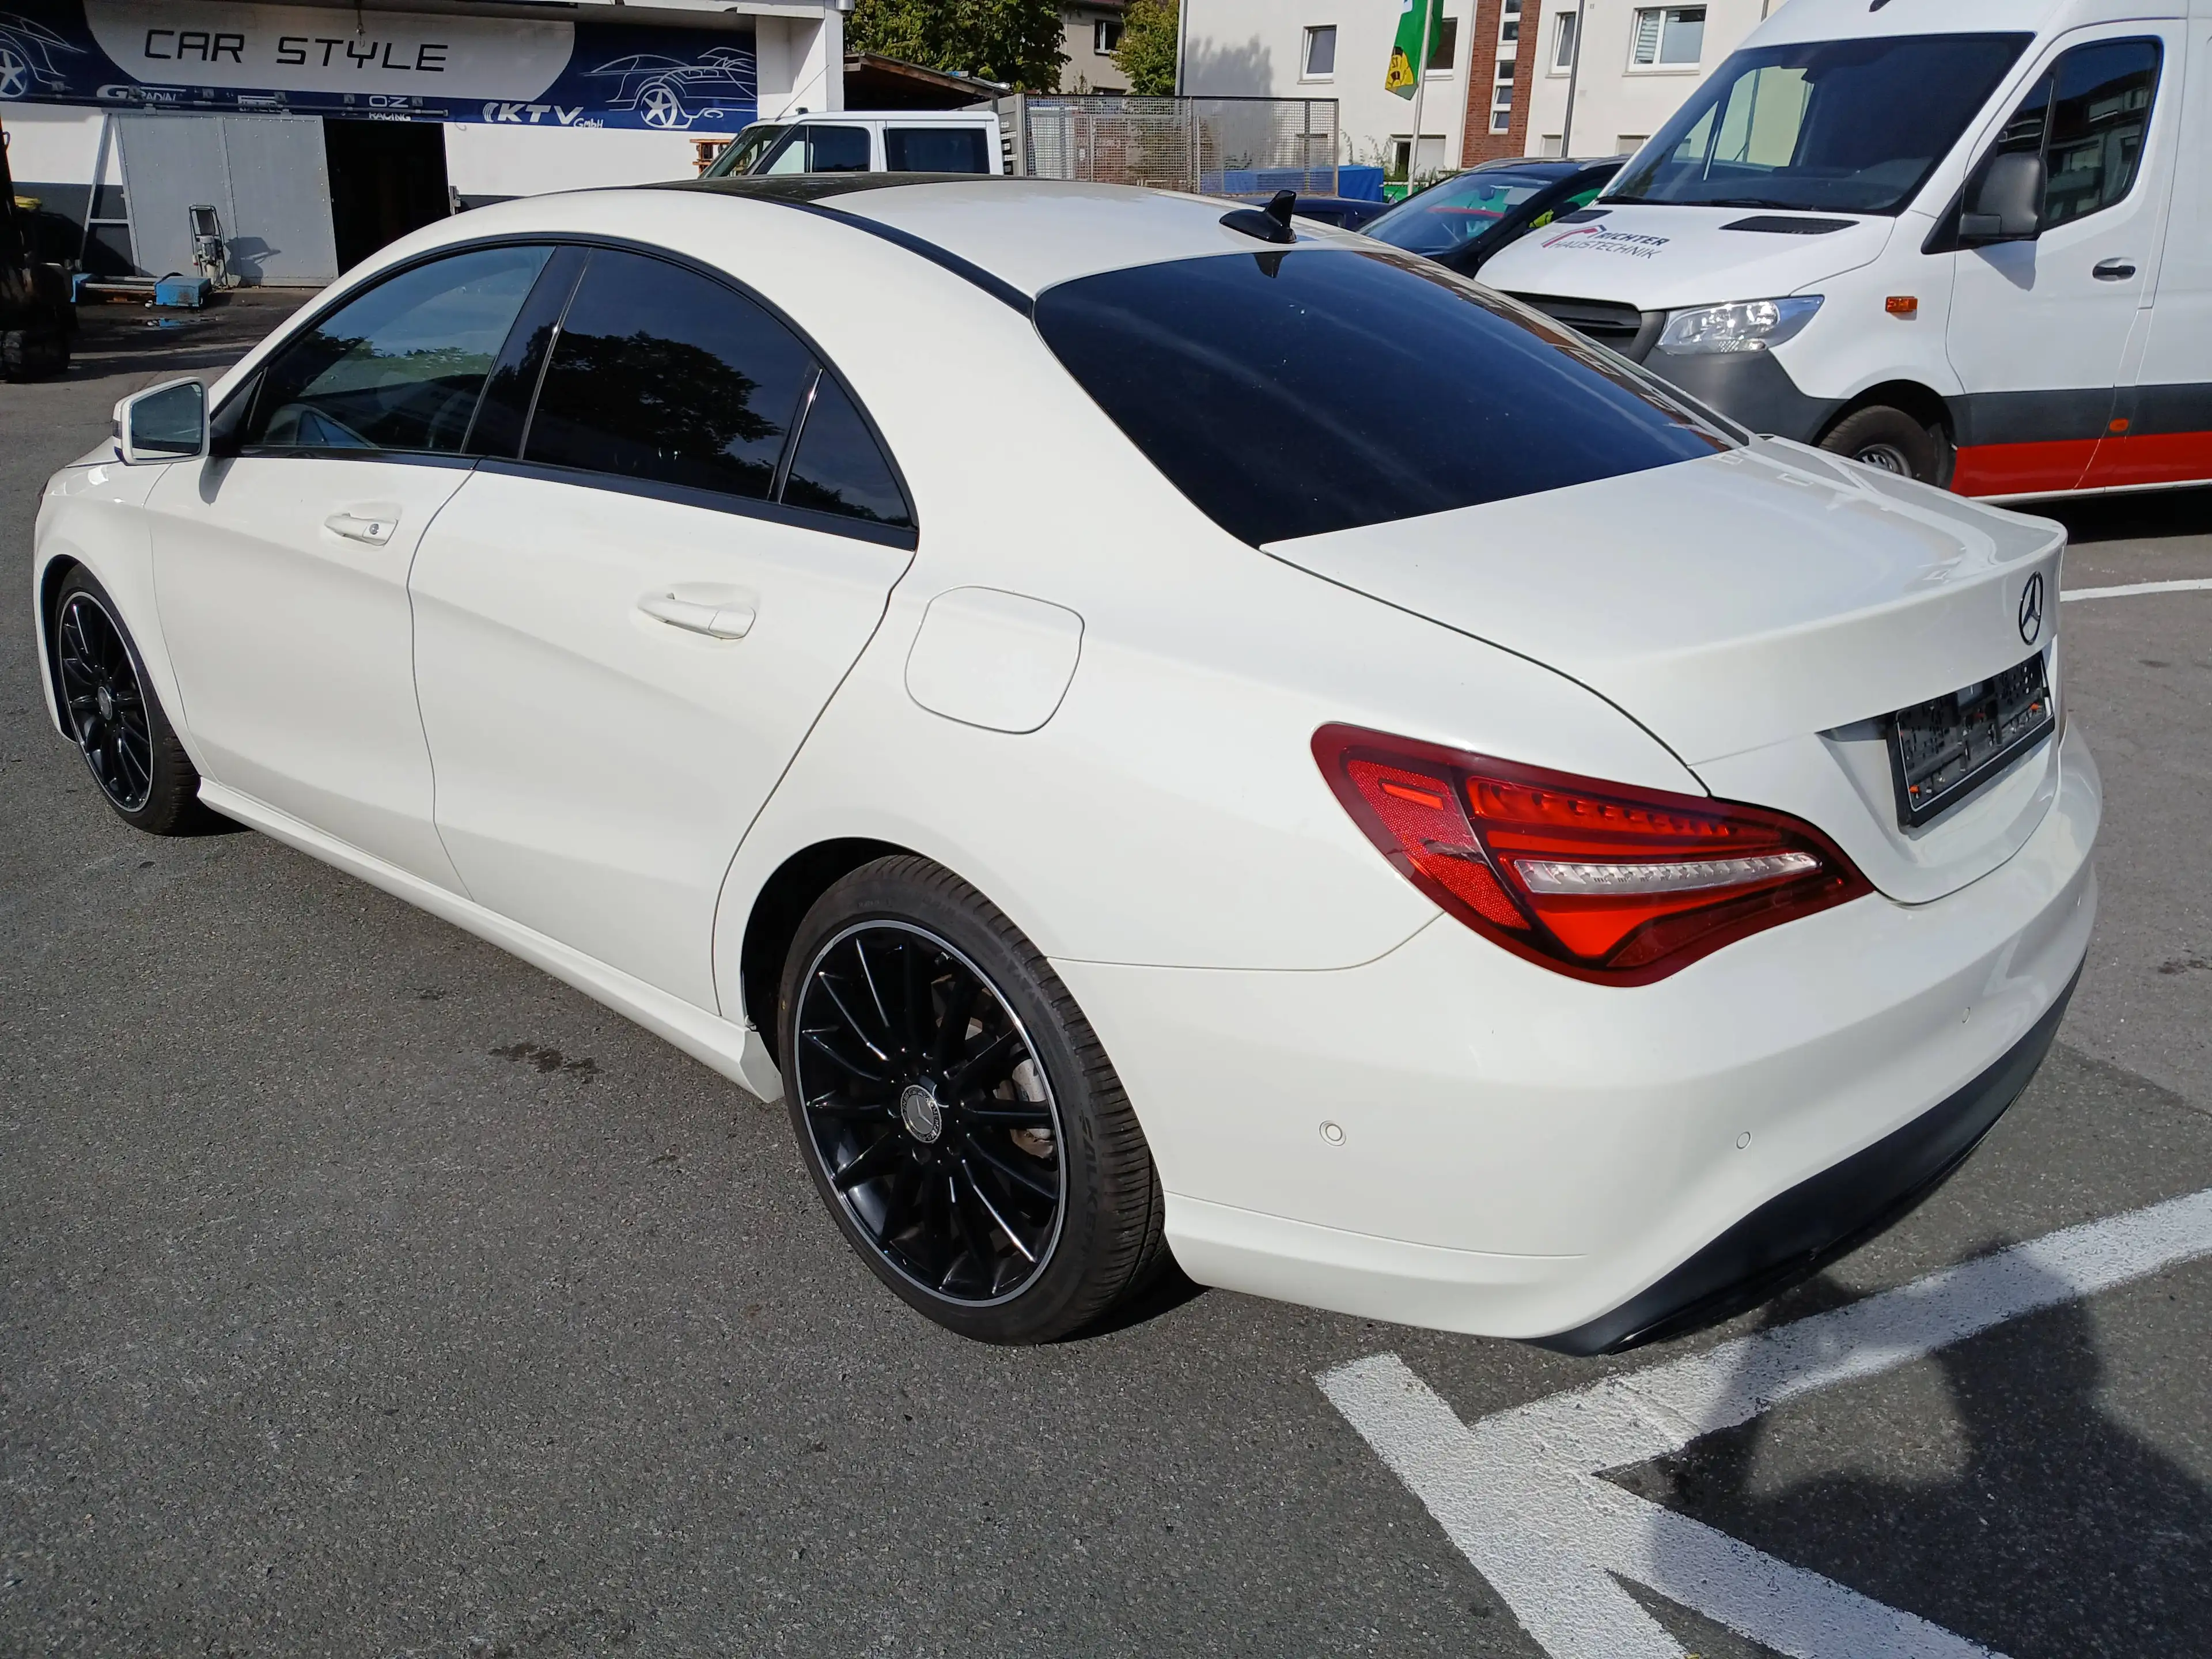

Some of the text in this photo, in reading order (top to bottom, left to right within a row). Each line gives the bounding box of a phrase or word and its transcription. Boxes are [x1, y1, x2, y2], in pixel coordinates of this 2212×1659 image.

[145, 29, 448, 72] CAR STYLE
[497, 103, 604, 129] KTV GmbH
[1548, 240, 1662, 259] HAUSTECHNIK
[1594, 232, 1671, 247] RICHTER
